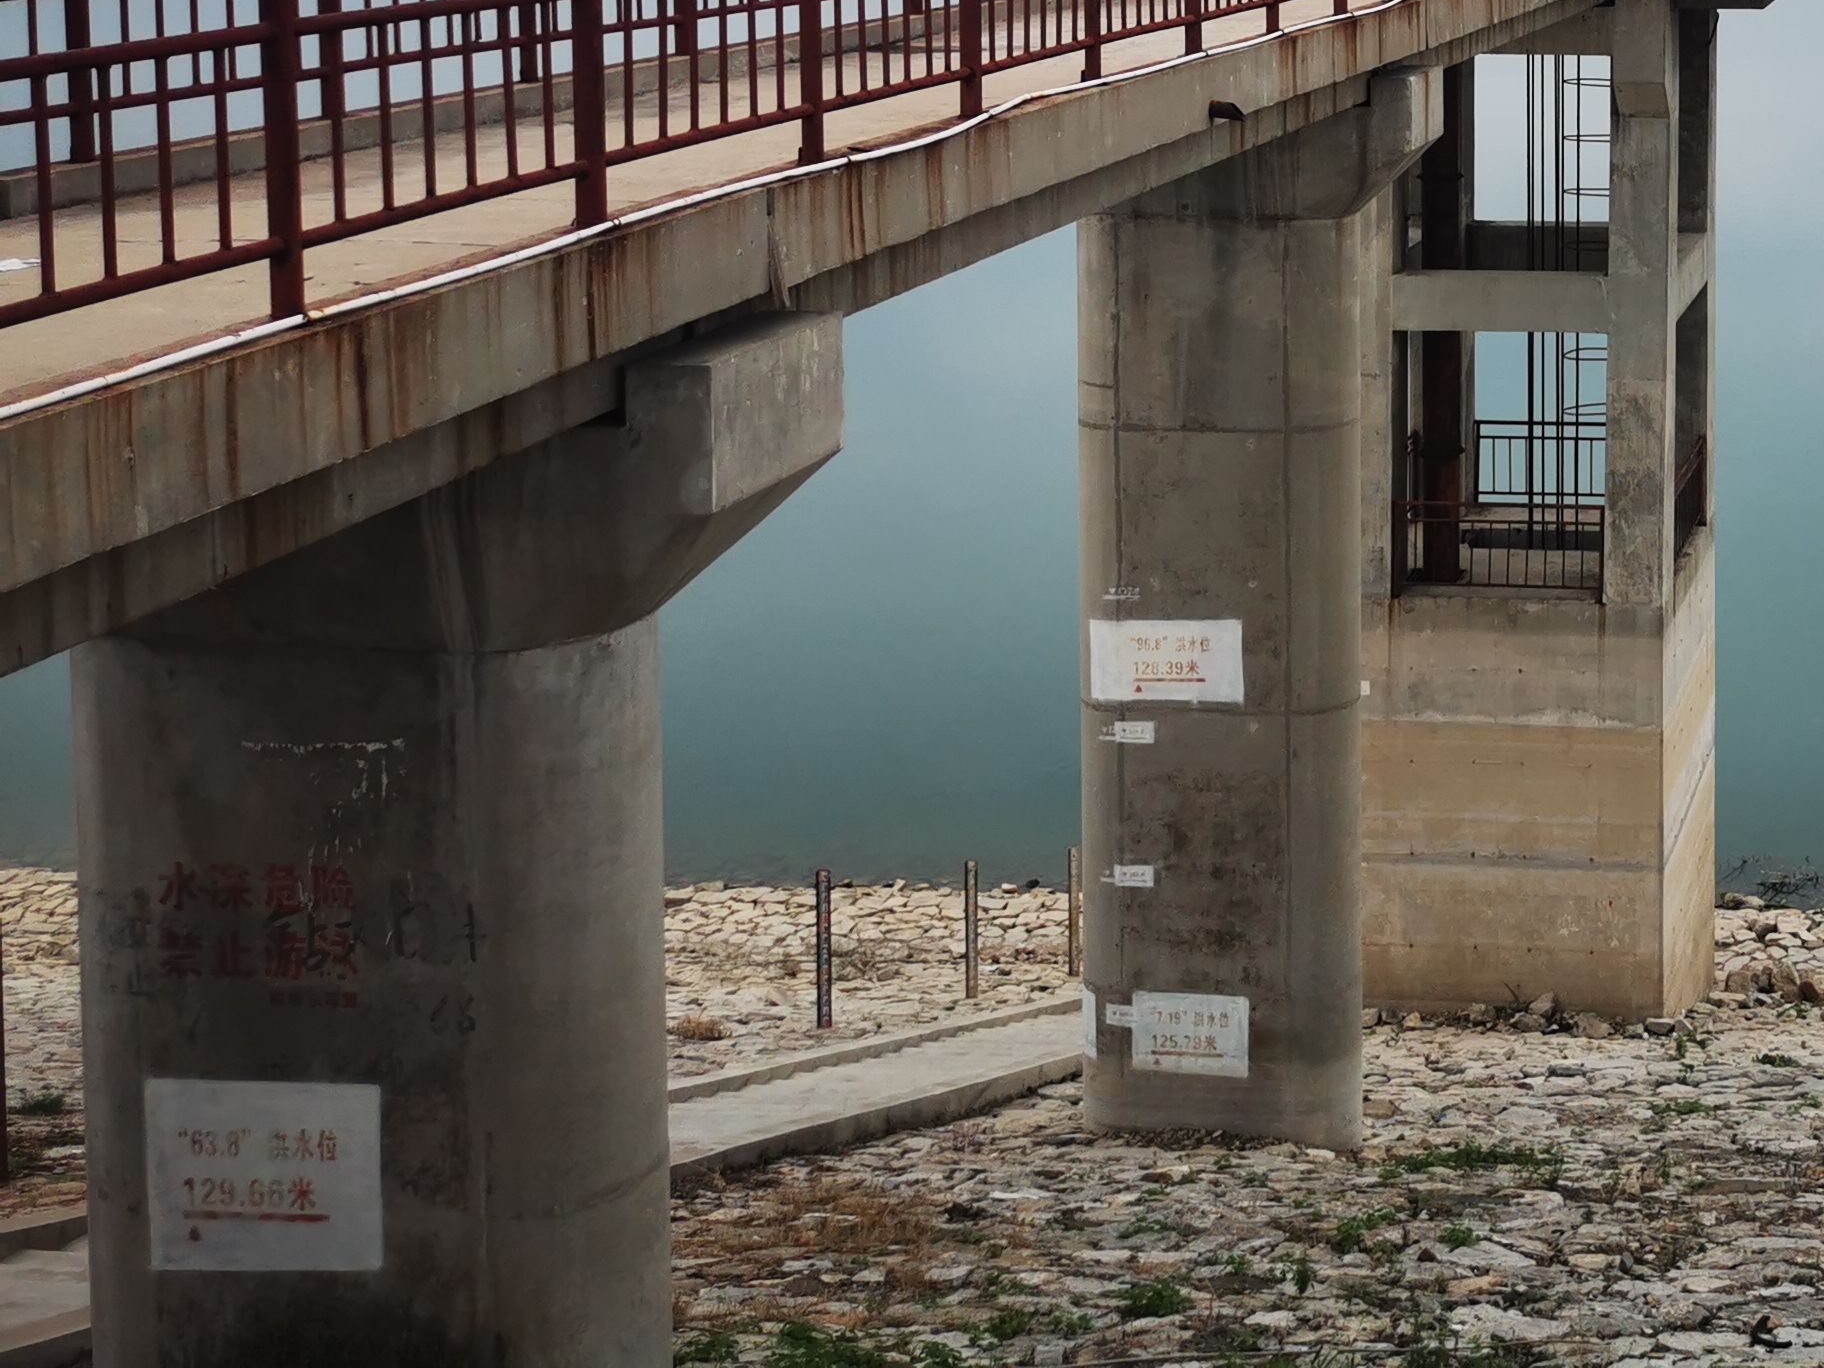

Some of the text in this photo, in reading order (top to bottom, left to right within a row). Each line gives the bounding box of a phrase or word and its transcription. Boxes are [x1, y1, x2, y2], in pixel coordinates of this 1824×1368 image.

[1133, 659, 1200, 676] 128.39米
[157, 860, 355, 911] 水深危险
[1151, 1034, 1217, 1051] 125.79米
[182, 1178, 317, 1211] 129.66米
